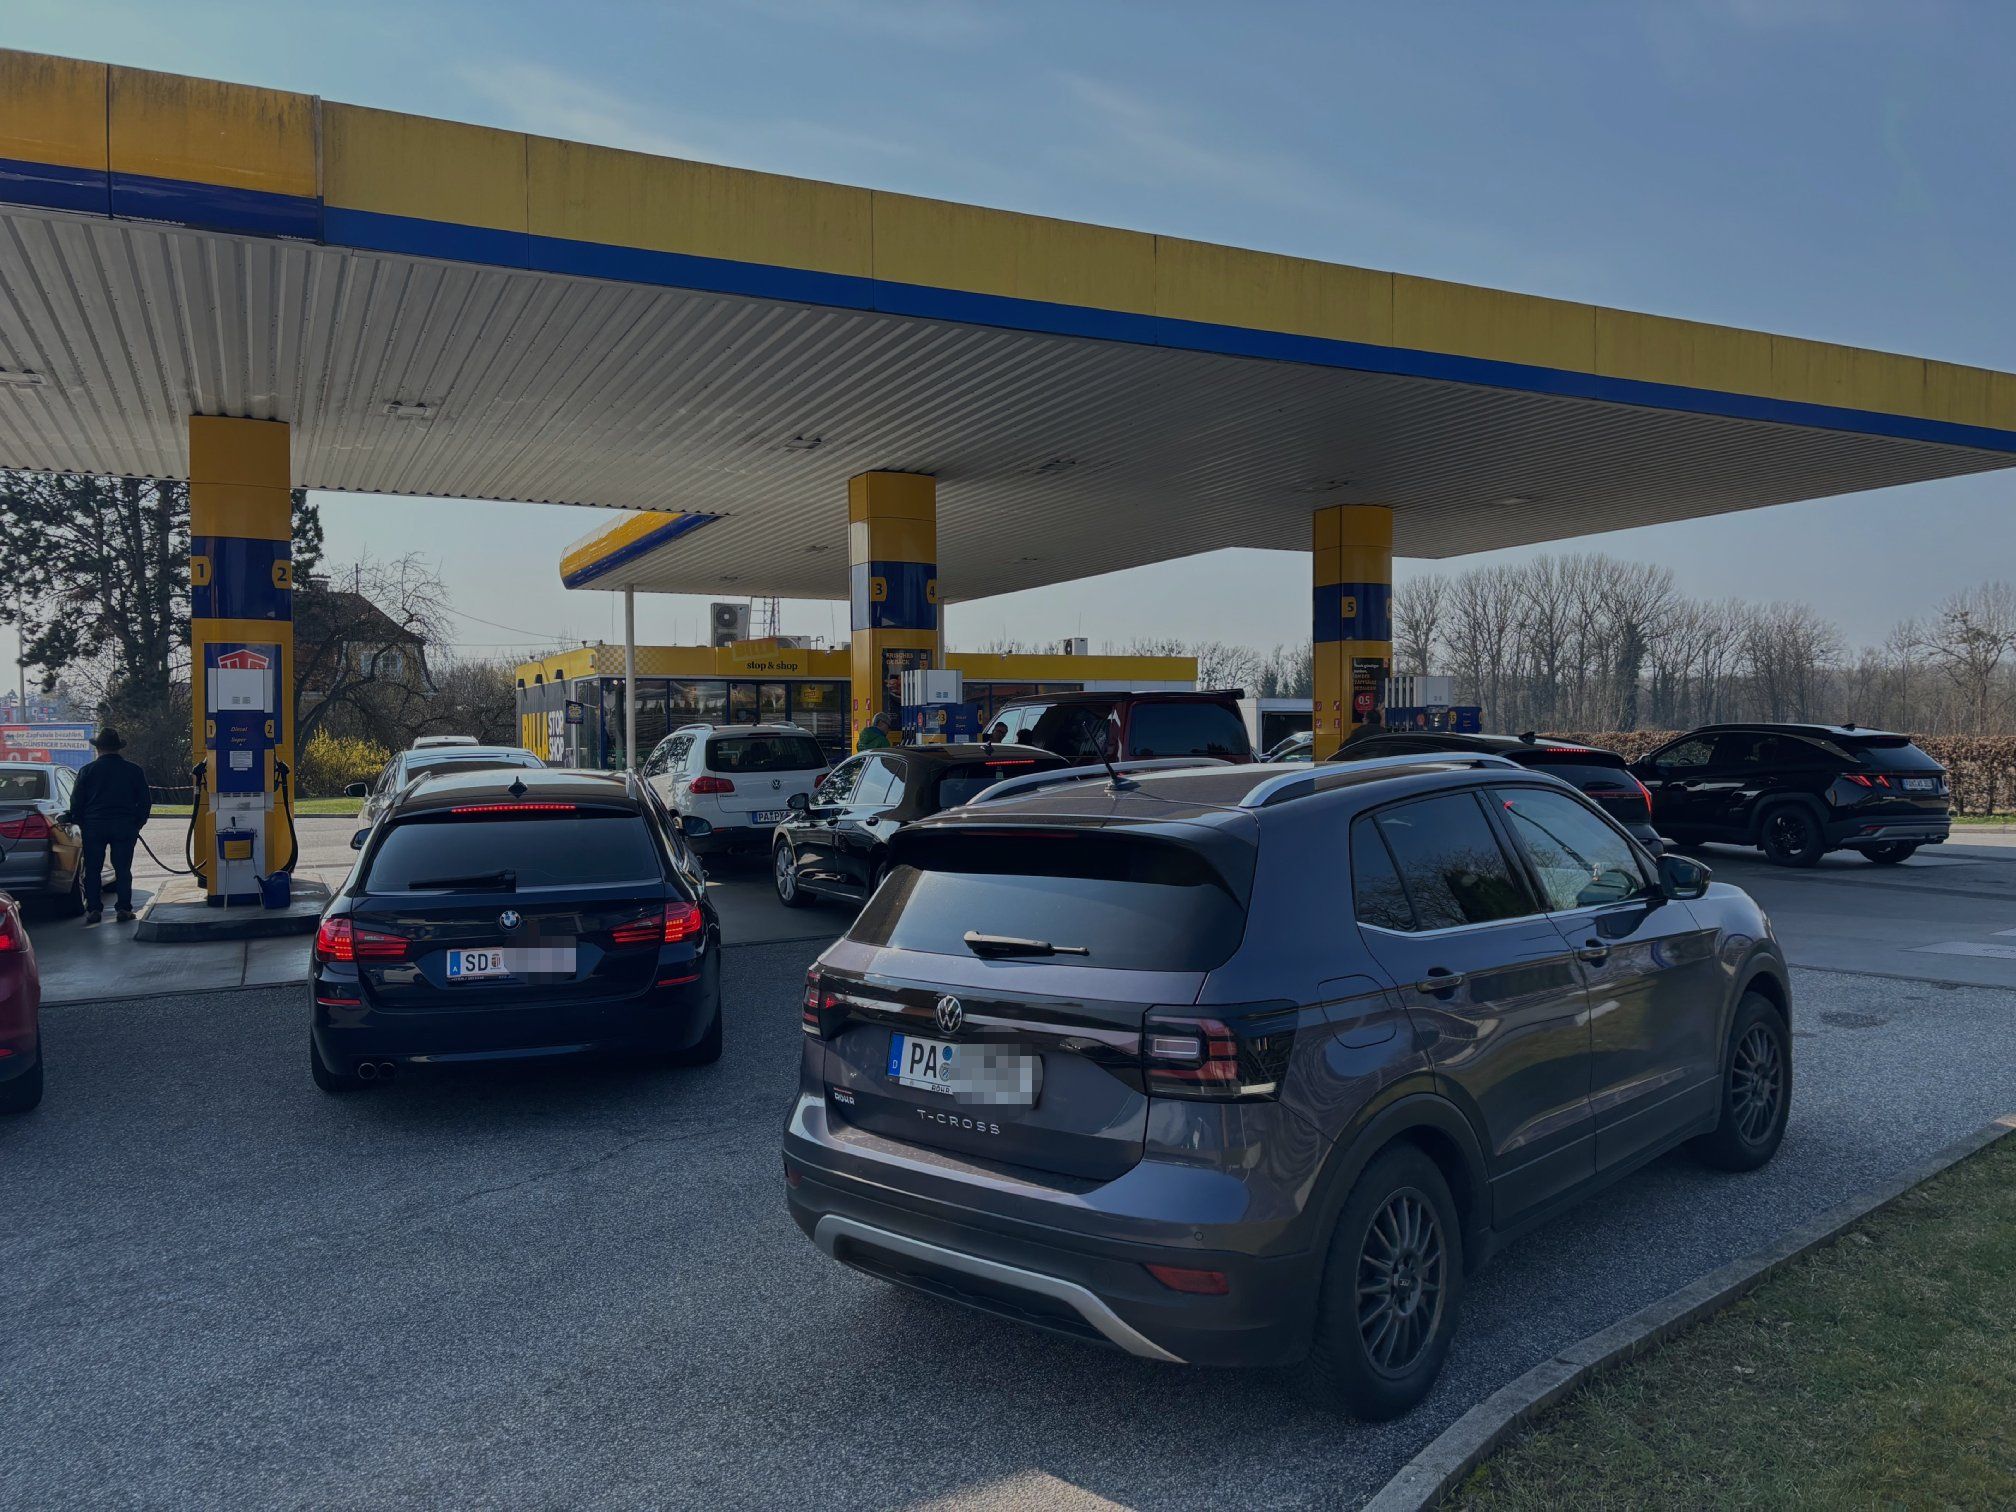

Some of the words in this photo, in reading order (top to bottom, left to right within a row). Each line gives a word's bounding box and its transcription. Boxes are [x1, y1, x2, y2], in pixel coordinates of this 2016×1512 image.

[197, 563, 204, 578] 1
[277, 567, 287, 582] 2
[875, 583, 882, 596] 3
[929, 586, 935, 598] 4
[1348, 601, 1354, 612] 5
[746, 661, 766, 671] stop
[776, 661, 798, 671] shop
[548, 710, 564, 736] STOP
[940, 713, 946, 721] 3
[209, 725, 213, 735] 1
[267, 725, 272, 733] 2
[549, 736, 564, 761] SHOP
[758, 812, 769, 821] PA
[466, 954, 488, 971] SD
[892, 1060, 898, 1069] D
[910, 1042, 937, 1078] PA
[917, 1109, 1001, 1135] T-CROSS
